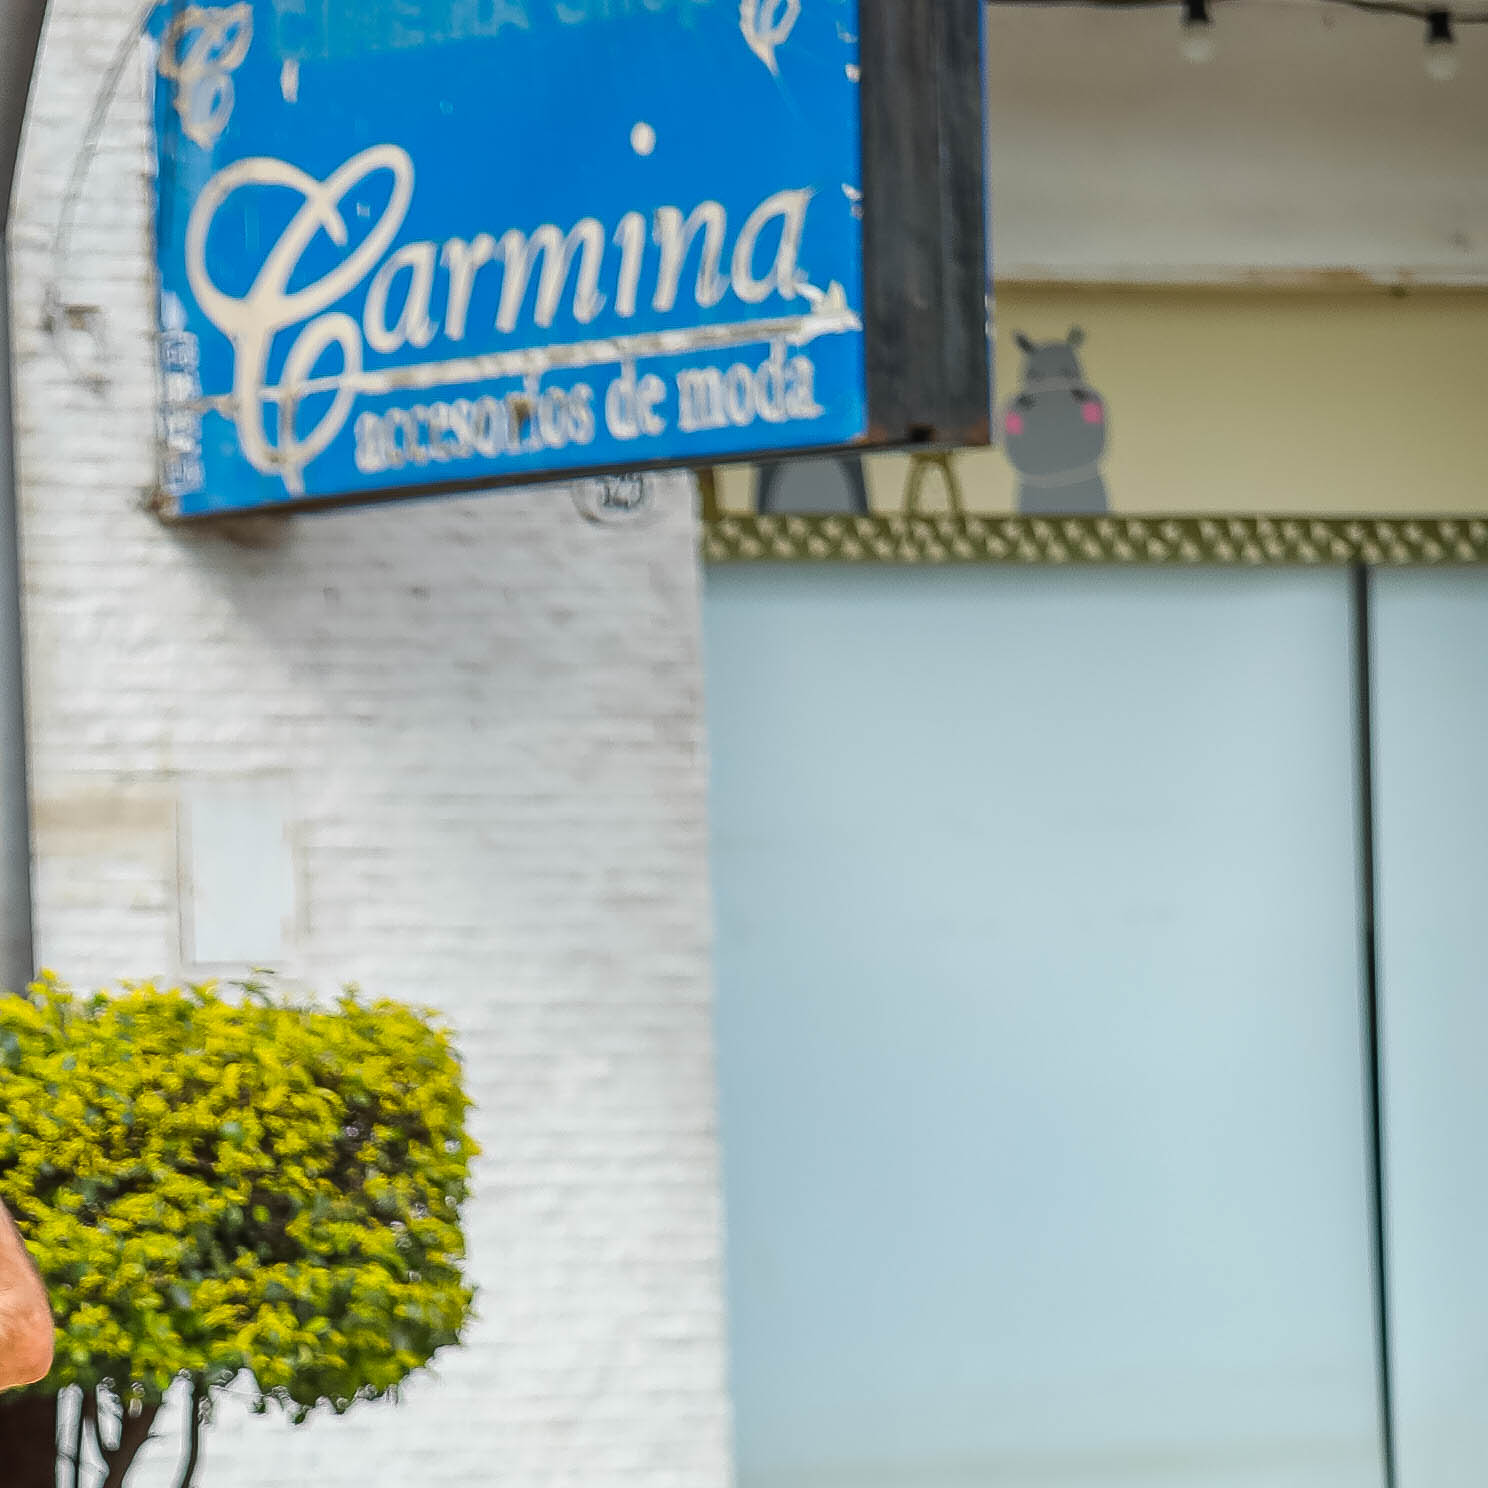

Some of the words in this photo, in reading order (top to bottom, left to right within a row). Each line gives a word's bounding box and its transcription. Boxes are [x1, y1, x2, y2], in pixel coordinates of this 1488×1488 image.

[186, 121, 818, 496] Carmina
[605, 358, 667, 441] de
[676, 340, 824, 433] moda
